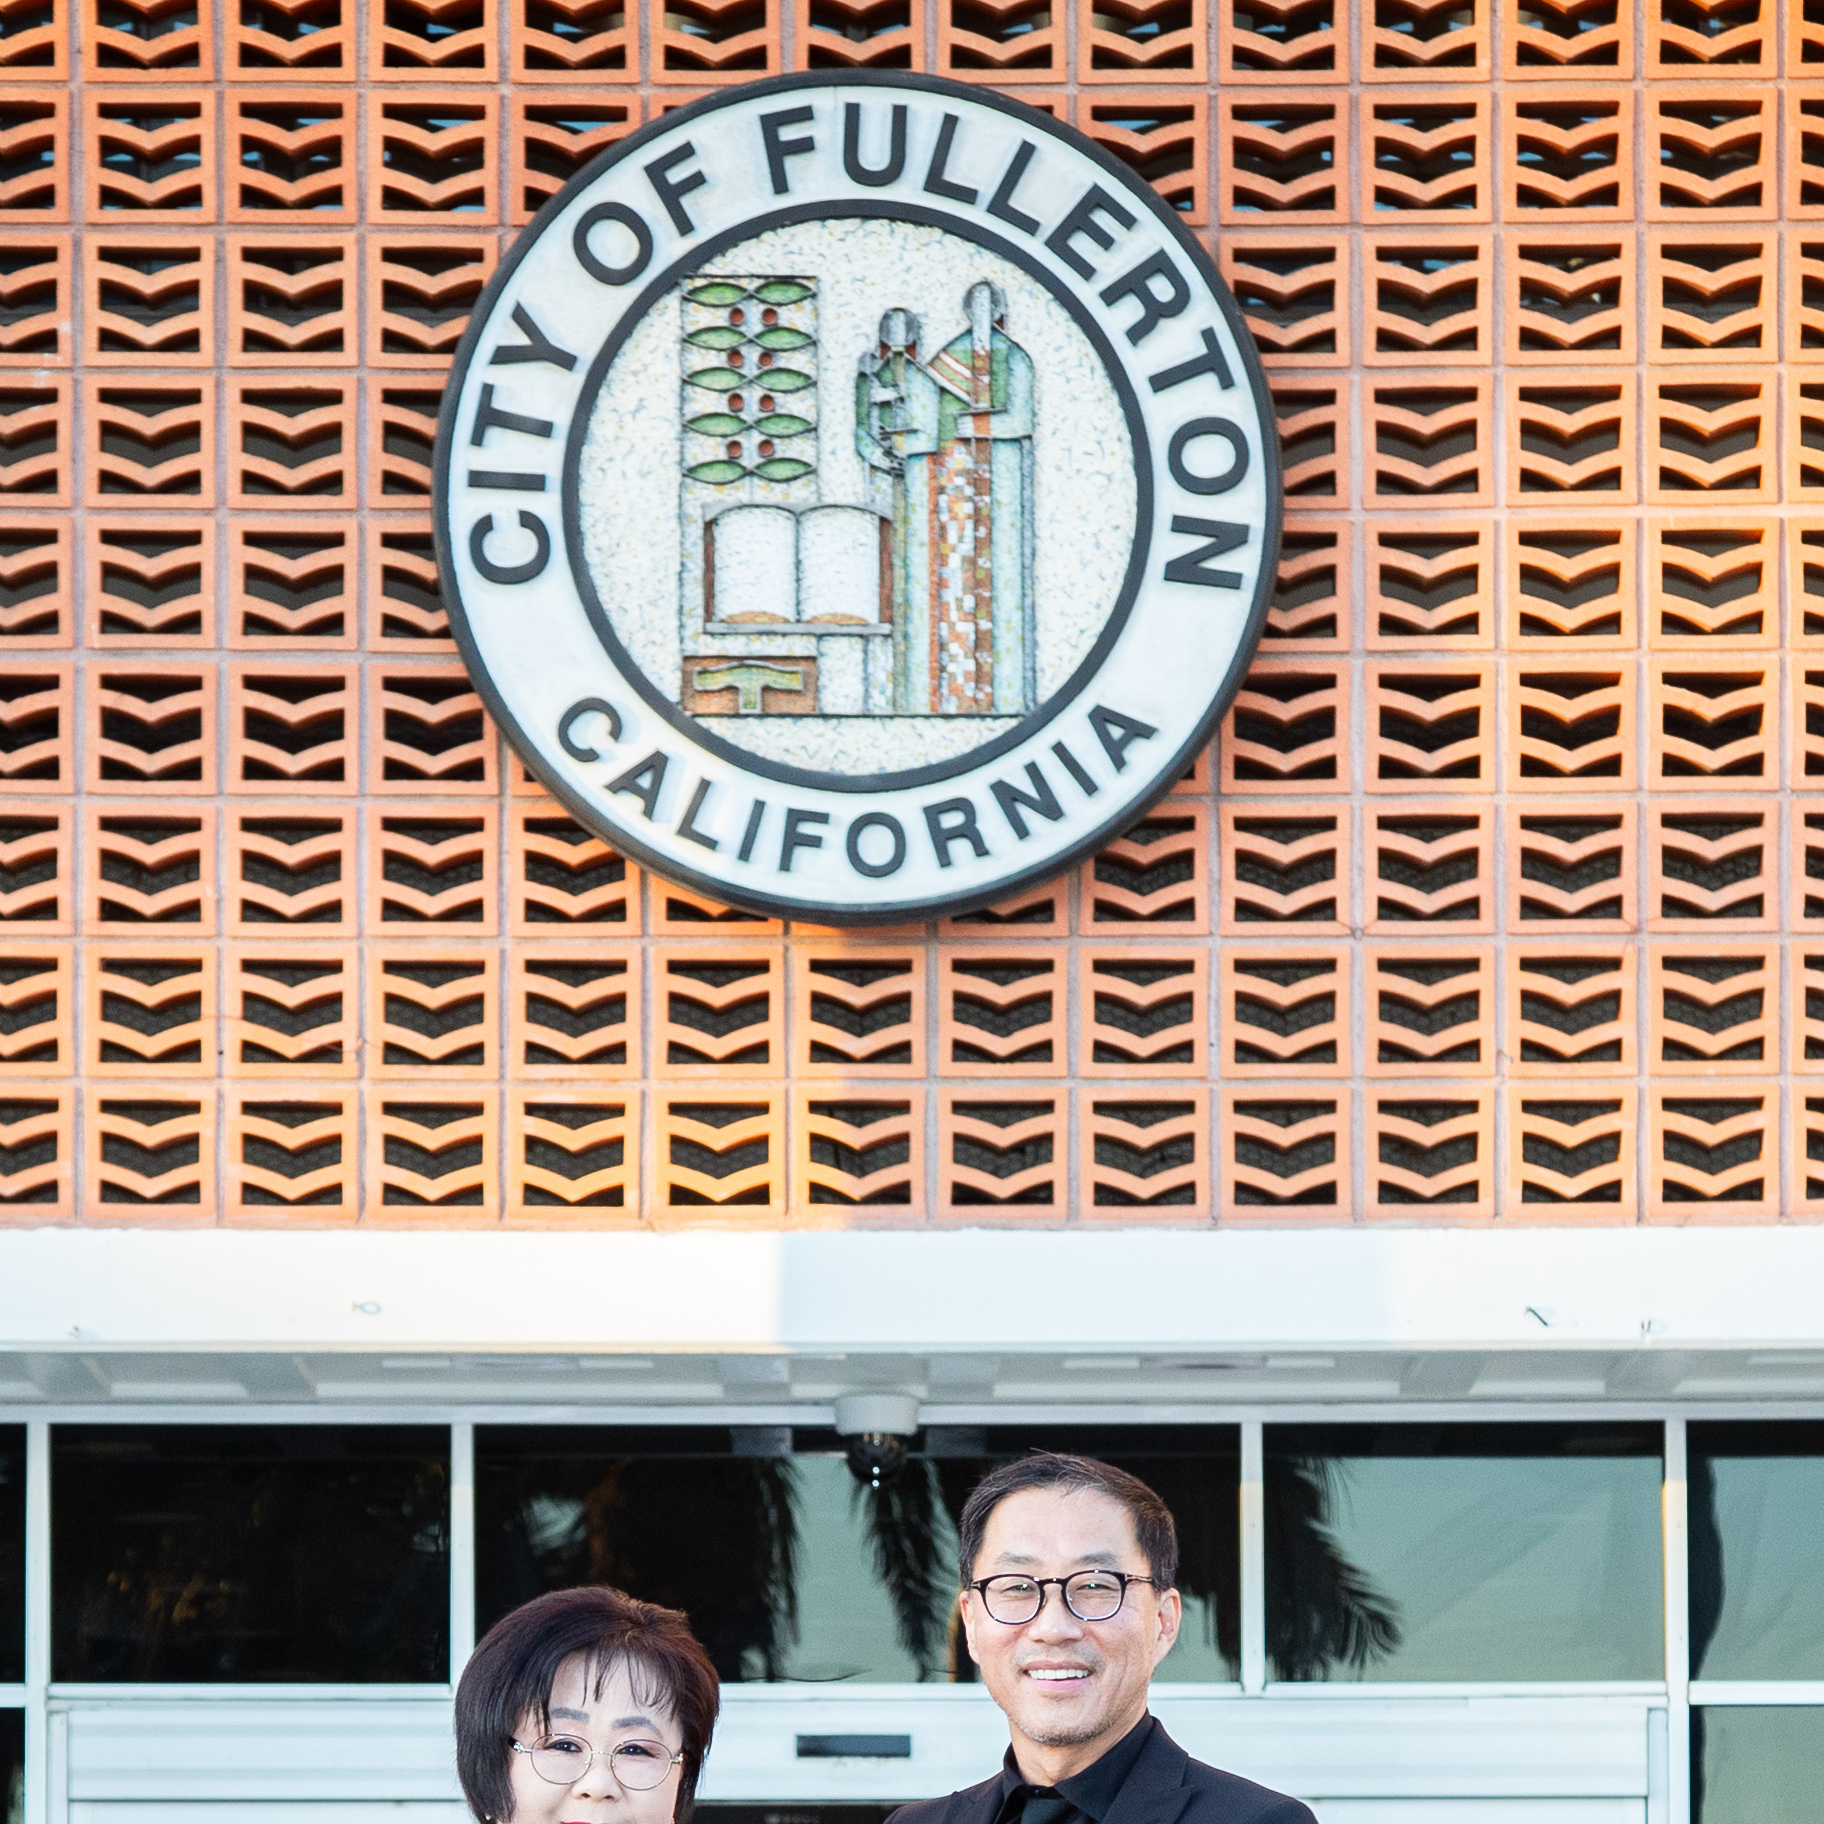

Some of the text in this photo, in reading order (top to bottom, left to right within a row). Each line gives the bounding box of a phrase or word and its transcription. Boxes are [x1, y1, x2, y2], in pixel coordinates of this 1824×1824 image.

[467, 101, 1251, 592] CITY OF FULLERTON
[556, 697, 1160, 880] CALIFORNIA
